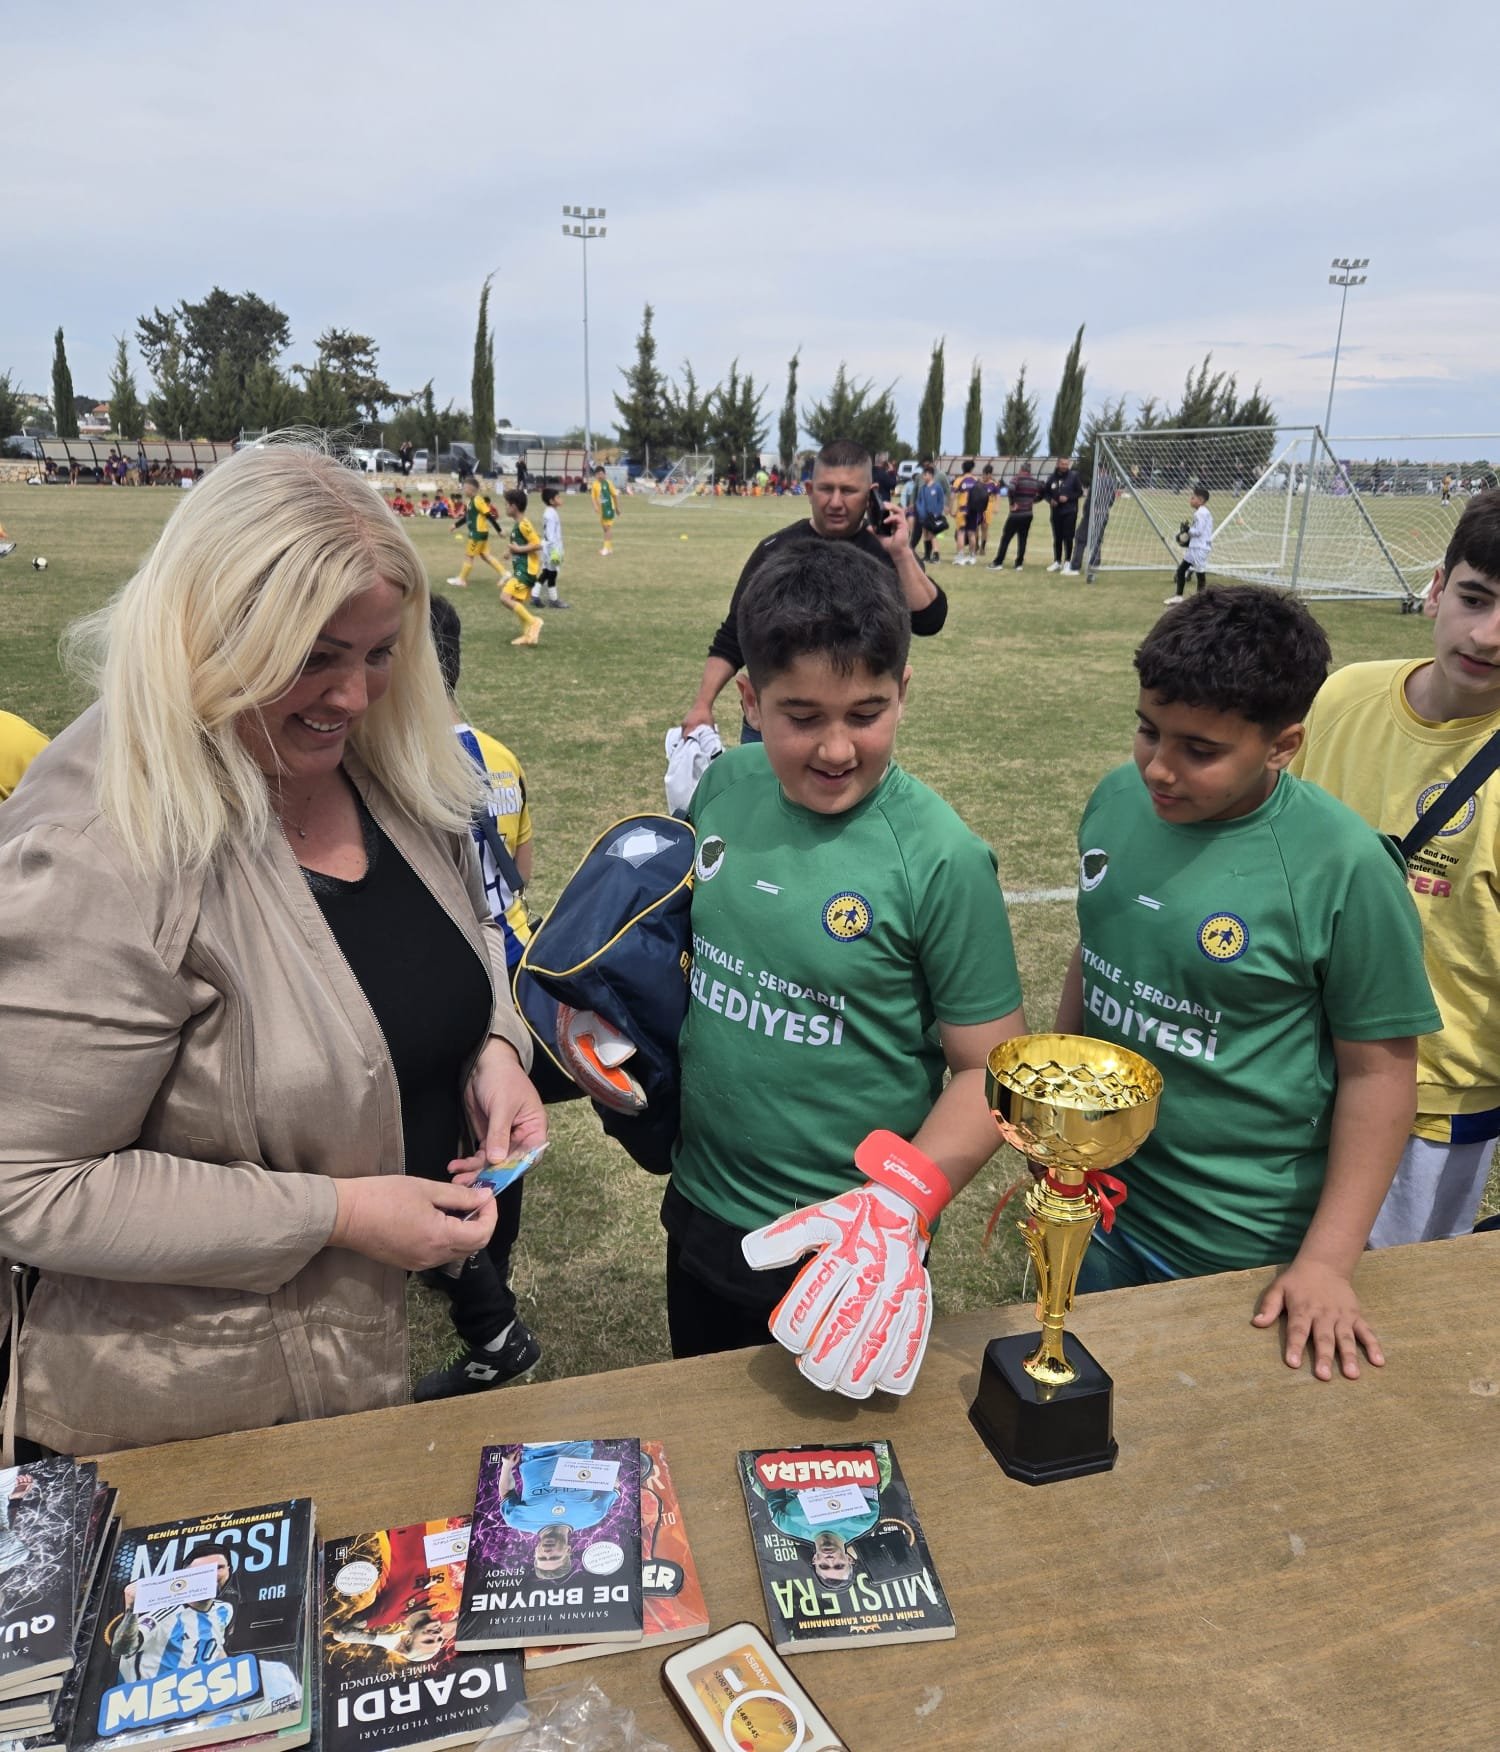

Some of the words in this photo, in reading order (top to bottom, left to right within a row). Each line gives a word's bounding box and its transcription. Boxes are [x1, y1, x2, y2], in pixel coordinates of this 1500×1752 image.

[1408, 873, 1452, 898] ER
[1132, 981, 1222, 1024] SERDARLI
[882, 1160, 932, 1195] reusch
[789, 1258, 839, 1334] reusch
[760, 1459, 874, 1482] MUSLERA
[182, 1522, 217, 1535] FUTBOL
[220, 1510, 284, 1528] KAHRAMANIM
[775, 1547, 798, 1562] ROB
[485, 1567, 525, 1578] ŞENSOY
[486, 1578, 523, 1588] AYHAN
[470, 1587, 583, 1612] BRUYNE
[594, 1585, 629, 1604] DE
[489, 1614, 553, 1625] YILDIZLARI
[559, 1610, 609, 1620] SAHANIN
[798, 1617, 858, 1630] KAHRAMANIM
[860, 1613, 894, 1625] FUTBOL
[896, 1609, 925, 1622] BENİM
[0, 1614, 56, 1644] QU
[400, 1661, 439, 1680] AHMET
[743, 1652, 771, 1687] ASBANK
[340, 1671, 396, 1692] KOYUNCU
[105, 1659, 253, 1730] MESSI
[337, 1662, 508, 1728] ICARDI
[435, 1704, 489, 1722] SAHANIN
[358, 1719, 430, 1740] YILDIZLARI
